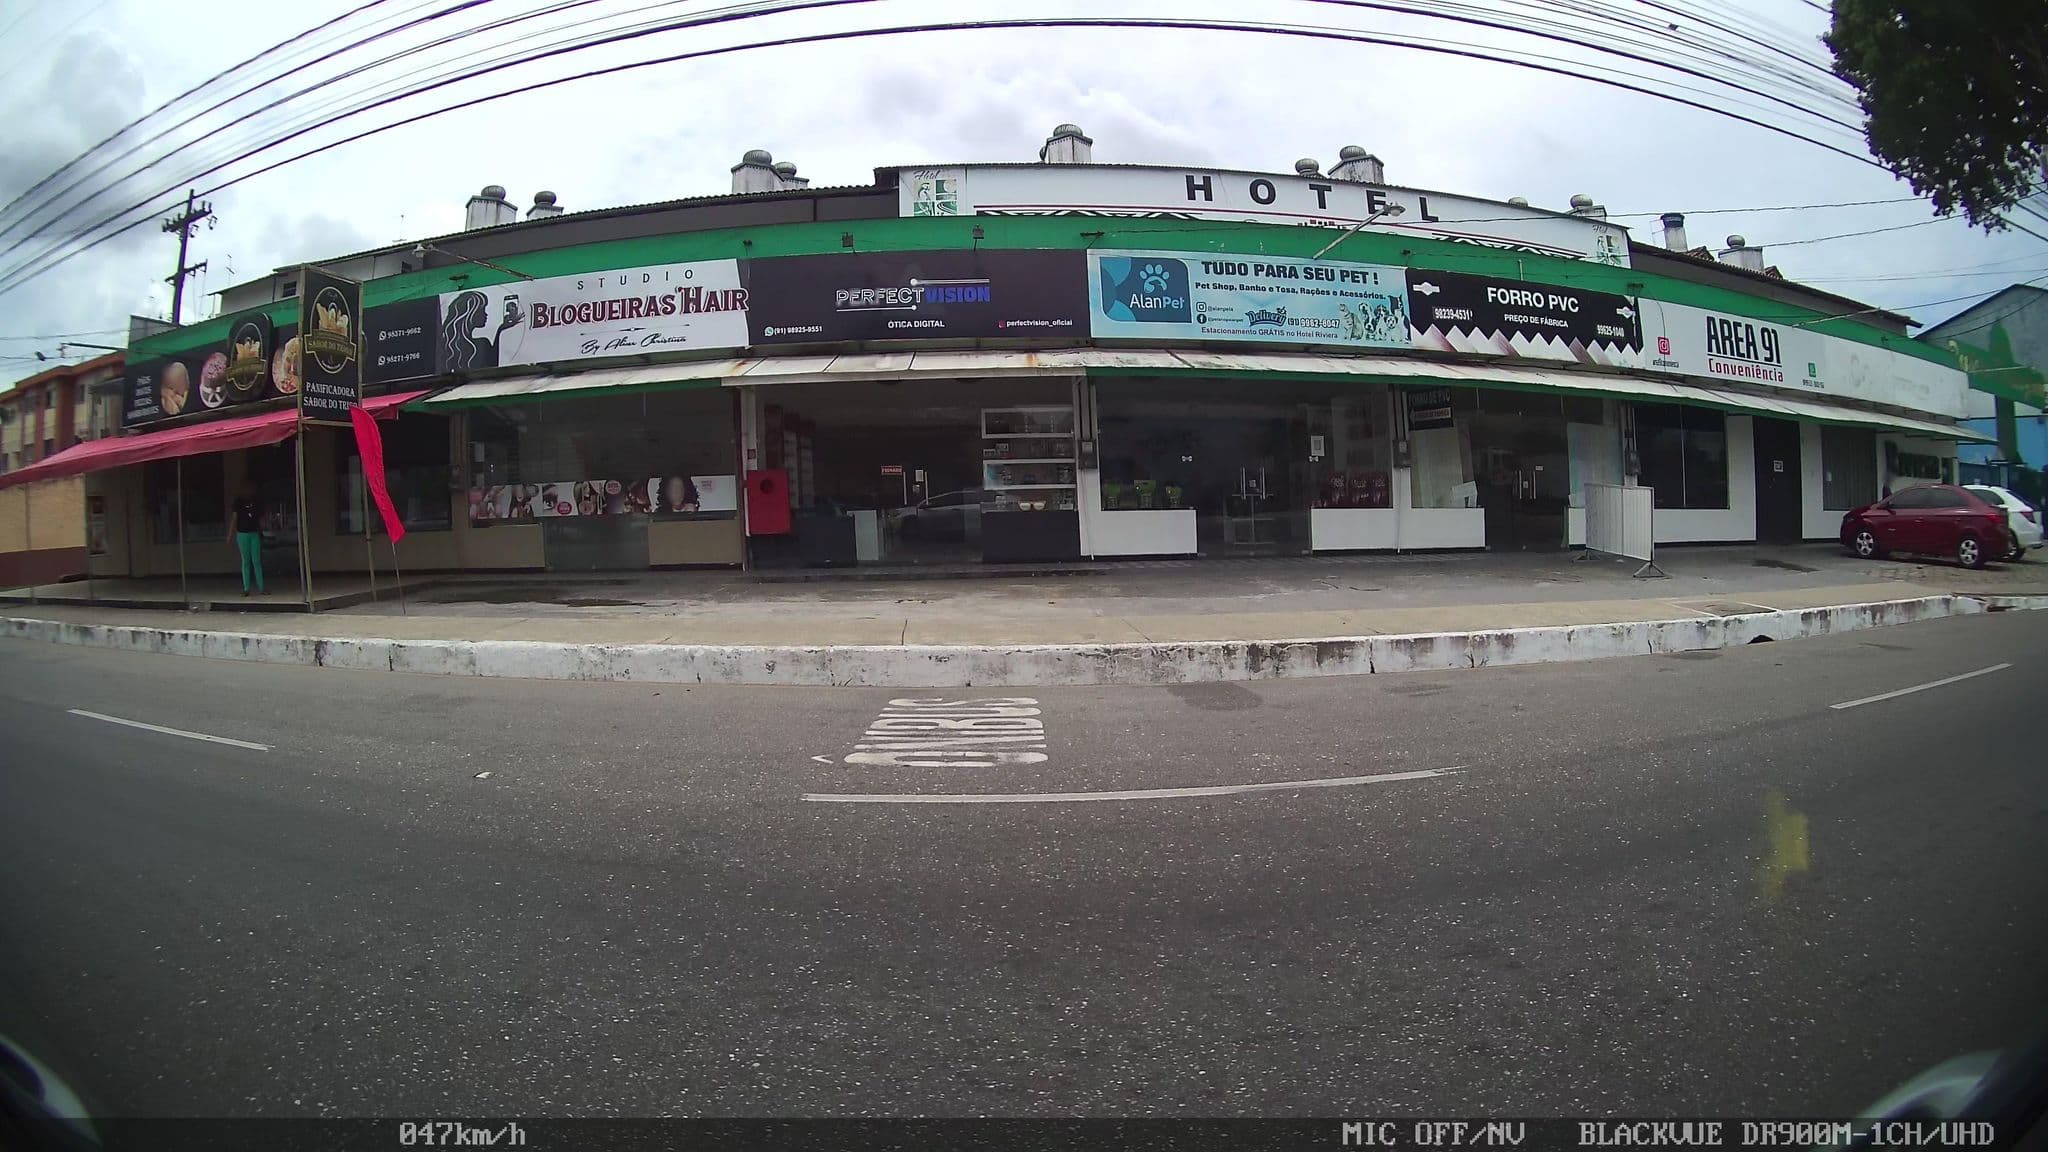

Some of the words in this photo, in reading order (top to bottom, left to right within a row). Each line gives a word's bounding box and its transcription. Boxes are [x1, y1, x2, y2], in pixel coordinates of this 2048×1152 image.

[1186, 174, 1439, 222] HOTEL
[577, 269, 694, 290] STUDIO
[1201, 261, 1248, 276] TUDO
[1254, 264, 1299, 279] PARA
[1304, 267, 1335, 281] SEU
[1340, 270, 1368, 284] PET
[836, 287, 924, 305] PERFECT
[925, 285, 991, 304] VISION
[1212, 283, 1238, 291] Shop,
[1239, 284, 1267, 292] Banho
[1275, 286, 1299, 294] Tosa,
[1129, 293, 1185, 309] AlanPet
[1486, 286, 1545, 308] FORRO
[1549, 293, 1580, 313] PVC
[913, 318, 945, 328] DIGITAL
[1250, 309, 1287, 326] Delivery
[1504, 313, 1529, 324] PREÇO
[1529, 315, 1541, 324] DE
[1541, 314, 1569, 328] FÁBRICA
[1201, 326, 1257, 336] Estacionamento
[1258, 328, 1285, 337] GRÁTIS
[1296, 330, 1314, 338] Hotel
[1315, 331, 1339, 339] Riviera
[1706, 315, 1759, 360] AREA
[1760, 326, 1782, 364] 91
[581, 339, 600, 355] By
[1708, 358, 1784, 382] Conveniência
[306, 382, 355, 397] PANIFICADORA
[303, 396, 327, 408] SABOR
[328, 399, 338, 409] DO
[811, 697, 1049, 768] ÔNIBUS
